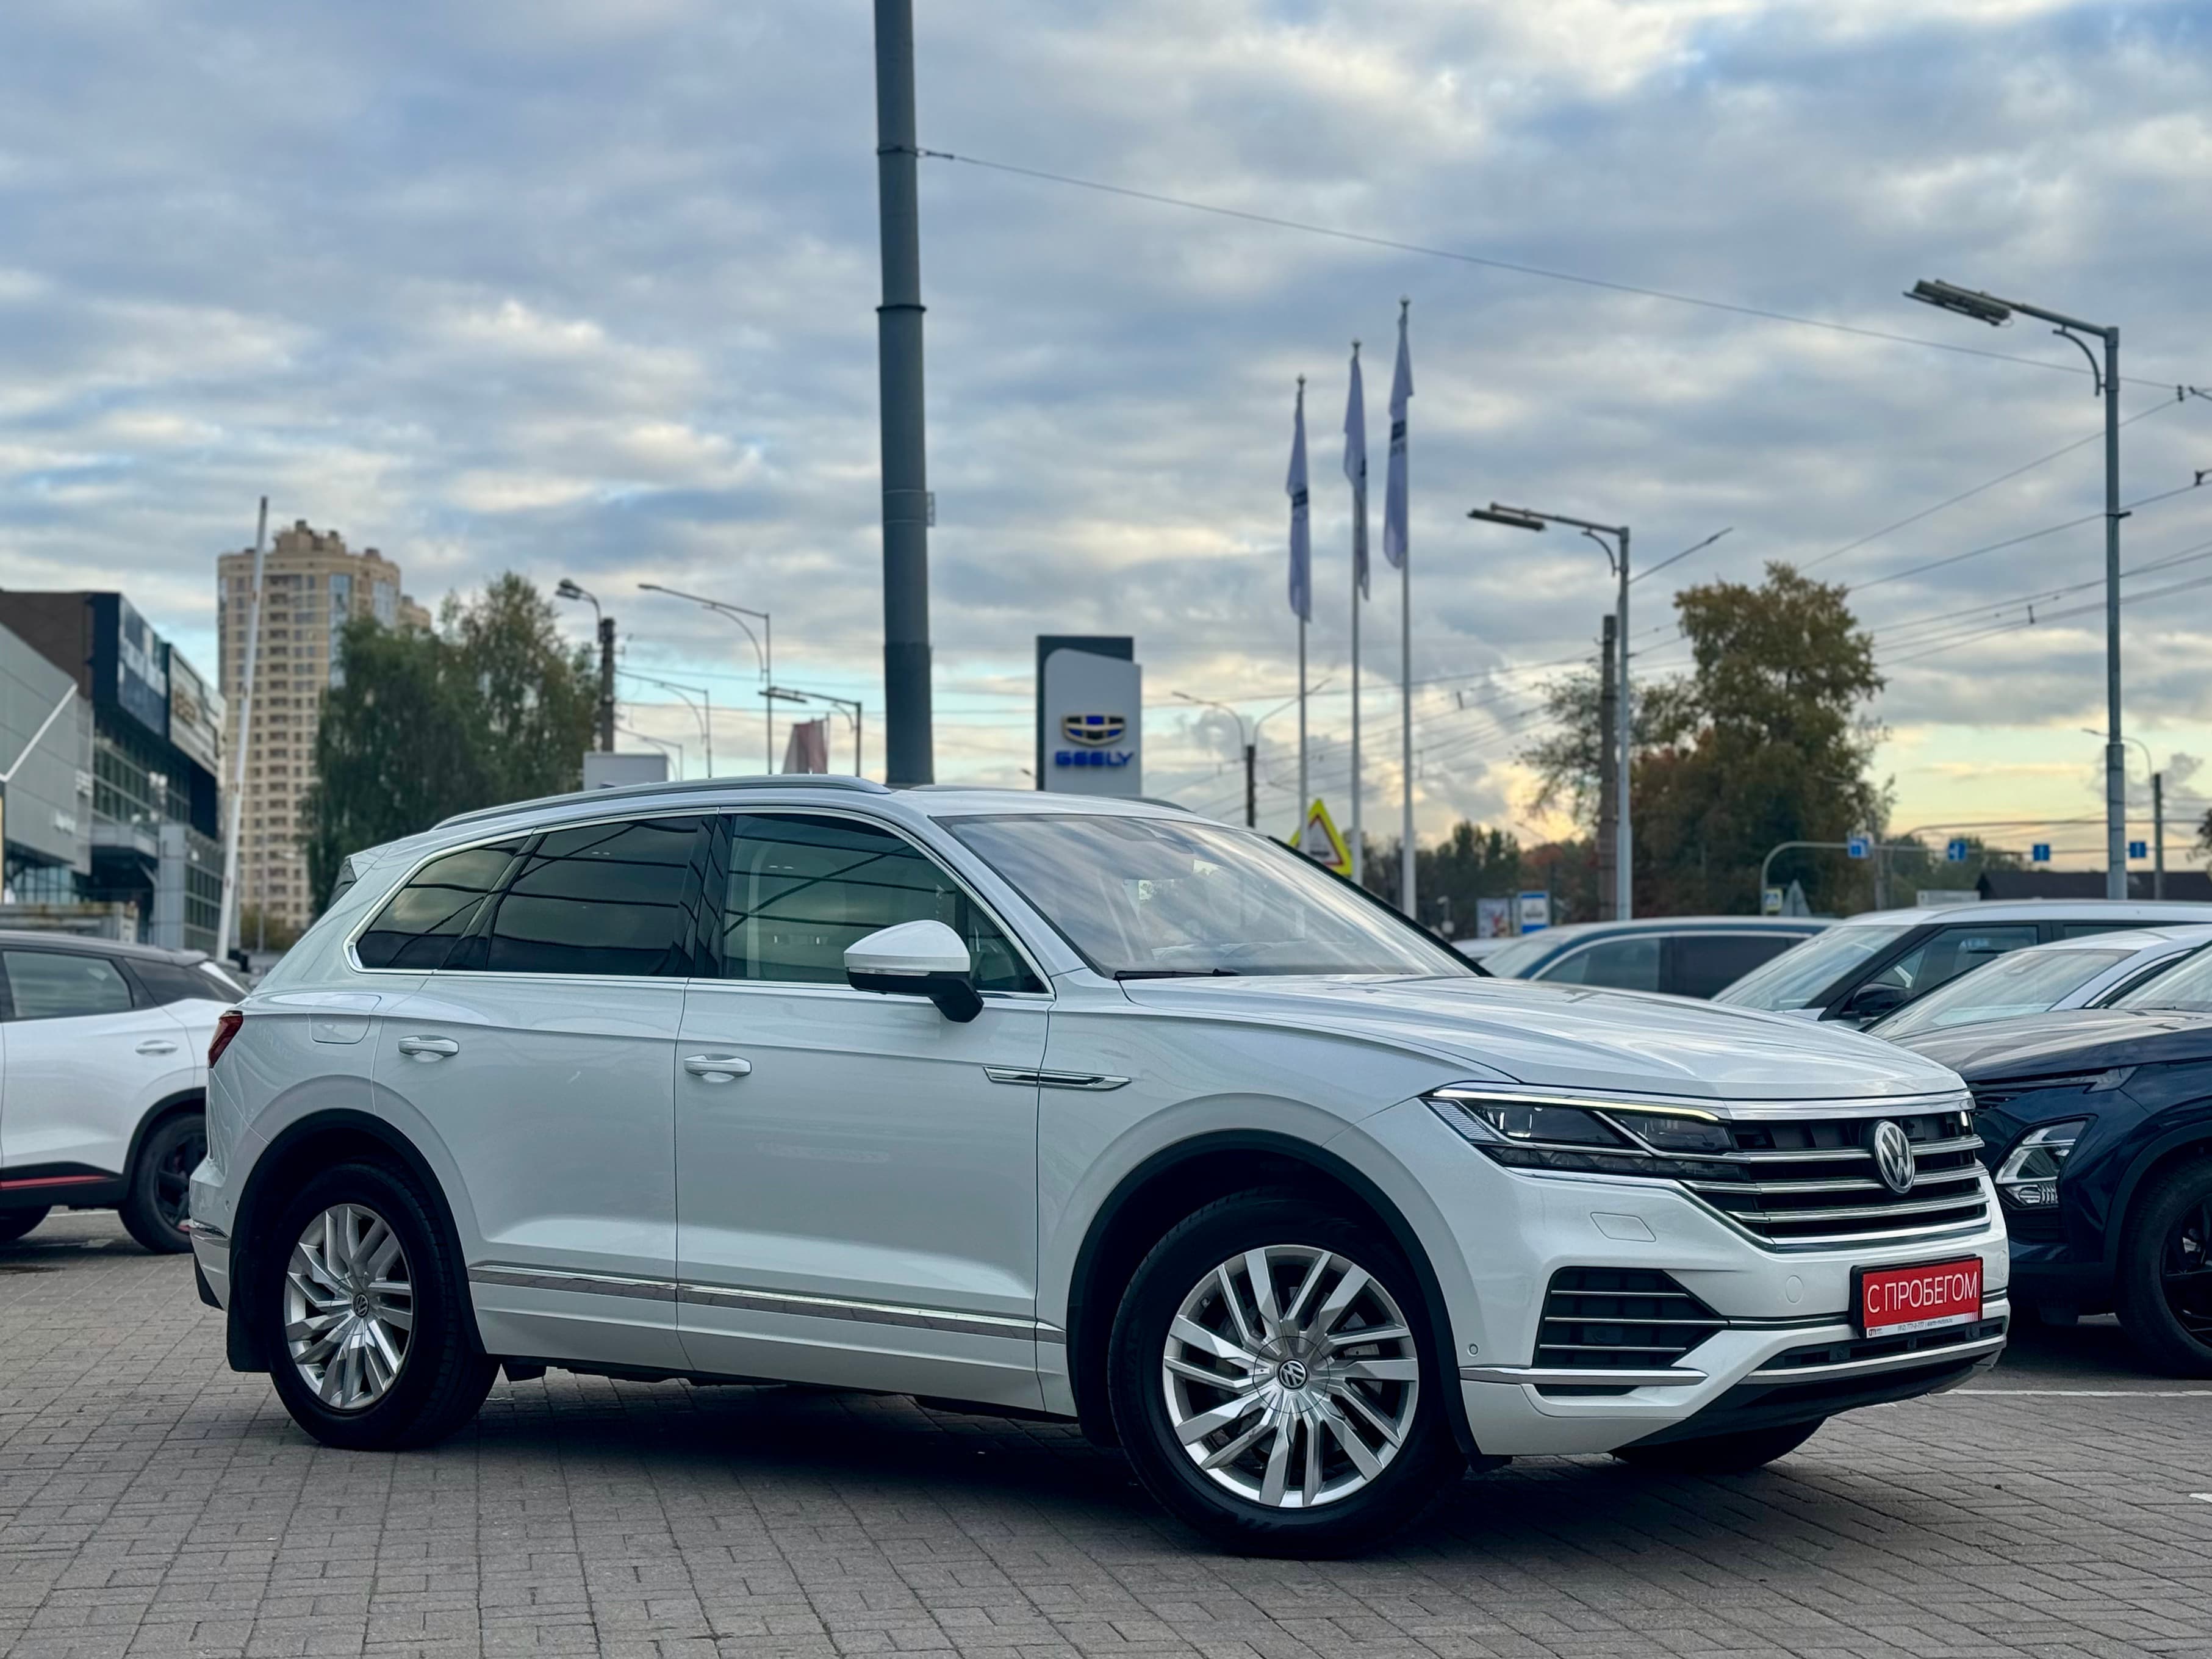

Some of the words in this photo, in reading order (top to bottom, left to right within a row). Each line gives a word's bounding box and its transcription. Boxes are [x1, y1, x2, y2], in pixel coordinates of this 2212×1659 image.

[1054, 750, 1135, 768] GEELY
[1867, 1284, 1880, 1313] С
[1884, 1271, 1978, 1312] ПРОБЕГОМ
